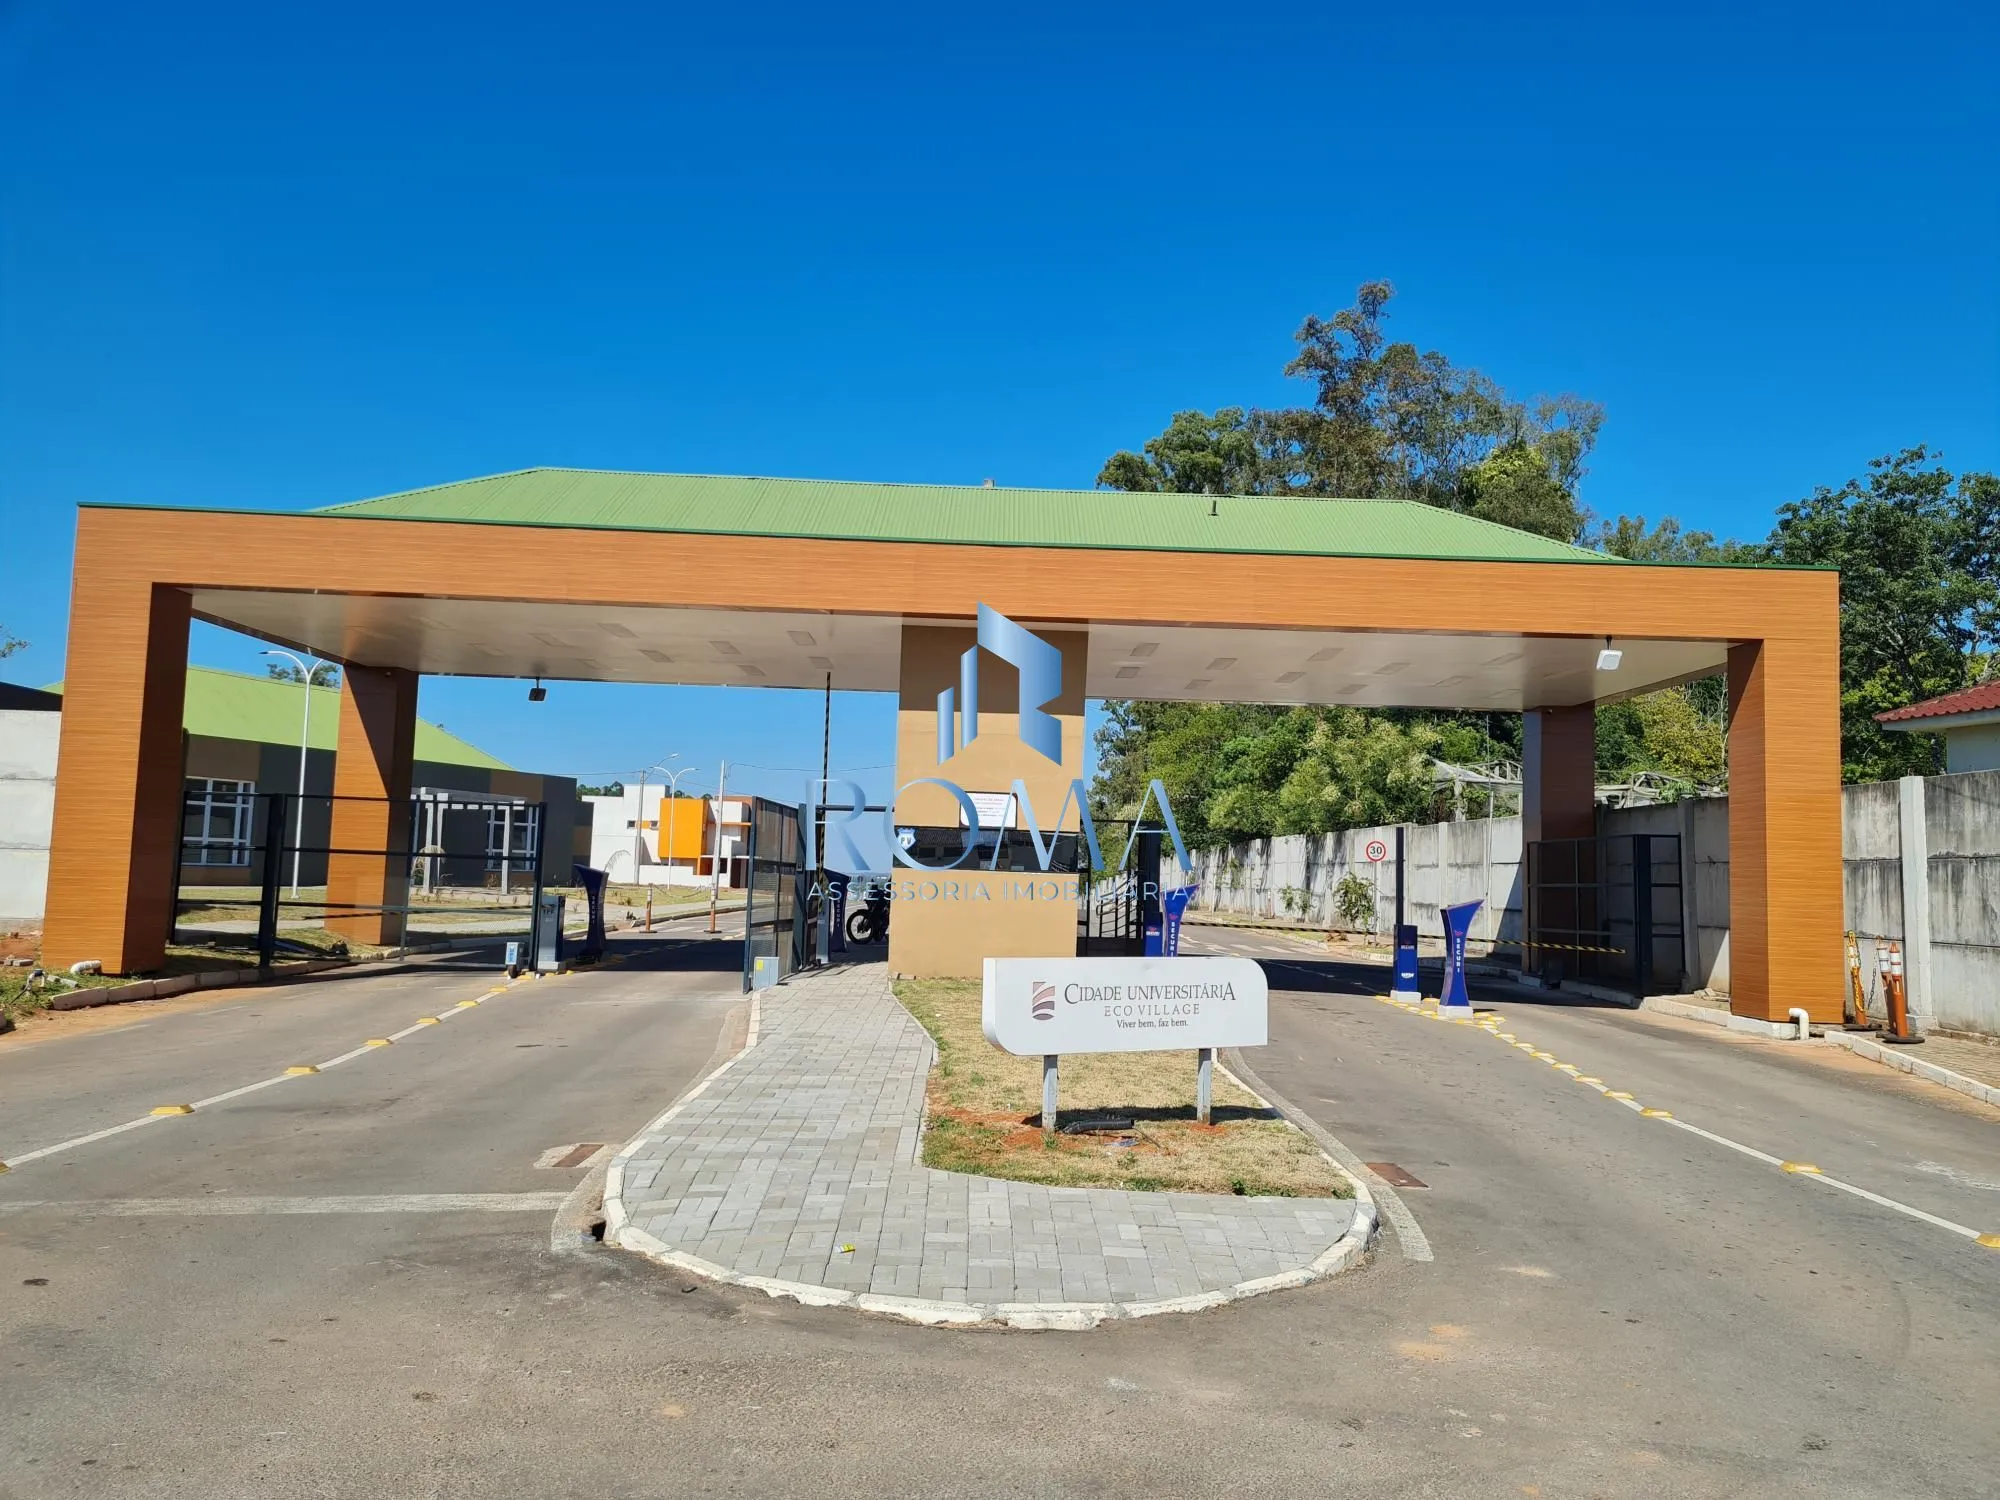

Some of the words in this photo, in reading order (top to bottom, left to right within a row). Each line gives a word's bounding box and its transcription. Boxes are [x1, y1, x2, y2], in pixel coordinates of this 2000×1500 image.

[1370, 846, 1383, 855] 30
[1104, 1005, 1133, 1017] ECO
[1138, 1003, 1201, 1016] VILLAGE
[1116, 1019, 1136, 1029] Viver
[1138, 1018, 1157, 1029] bem,
[1158, 1018, 1169, 1028] faz
[1171, 1018, 1189, 1027] bem.
